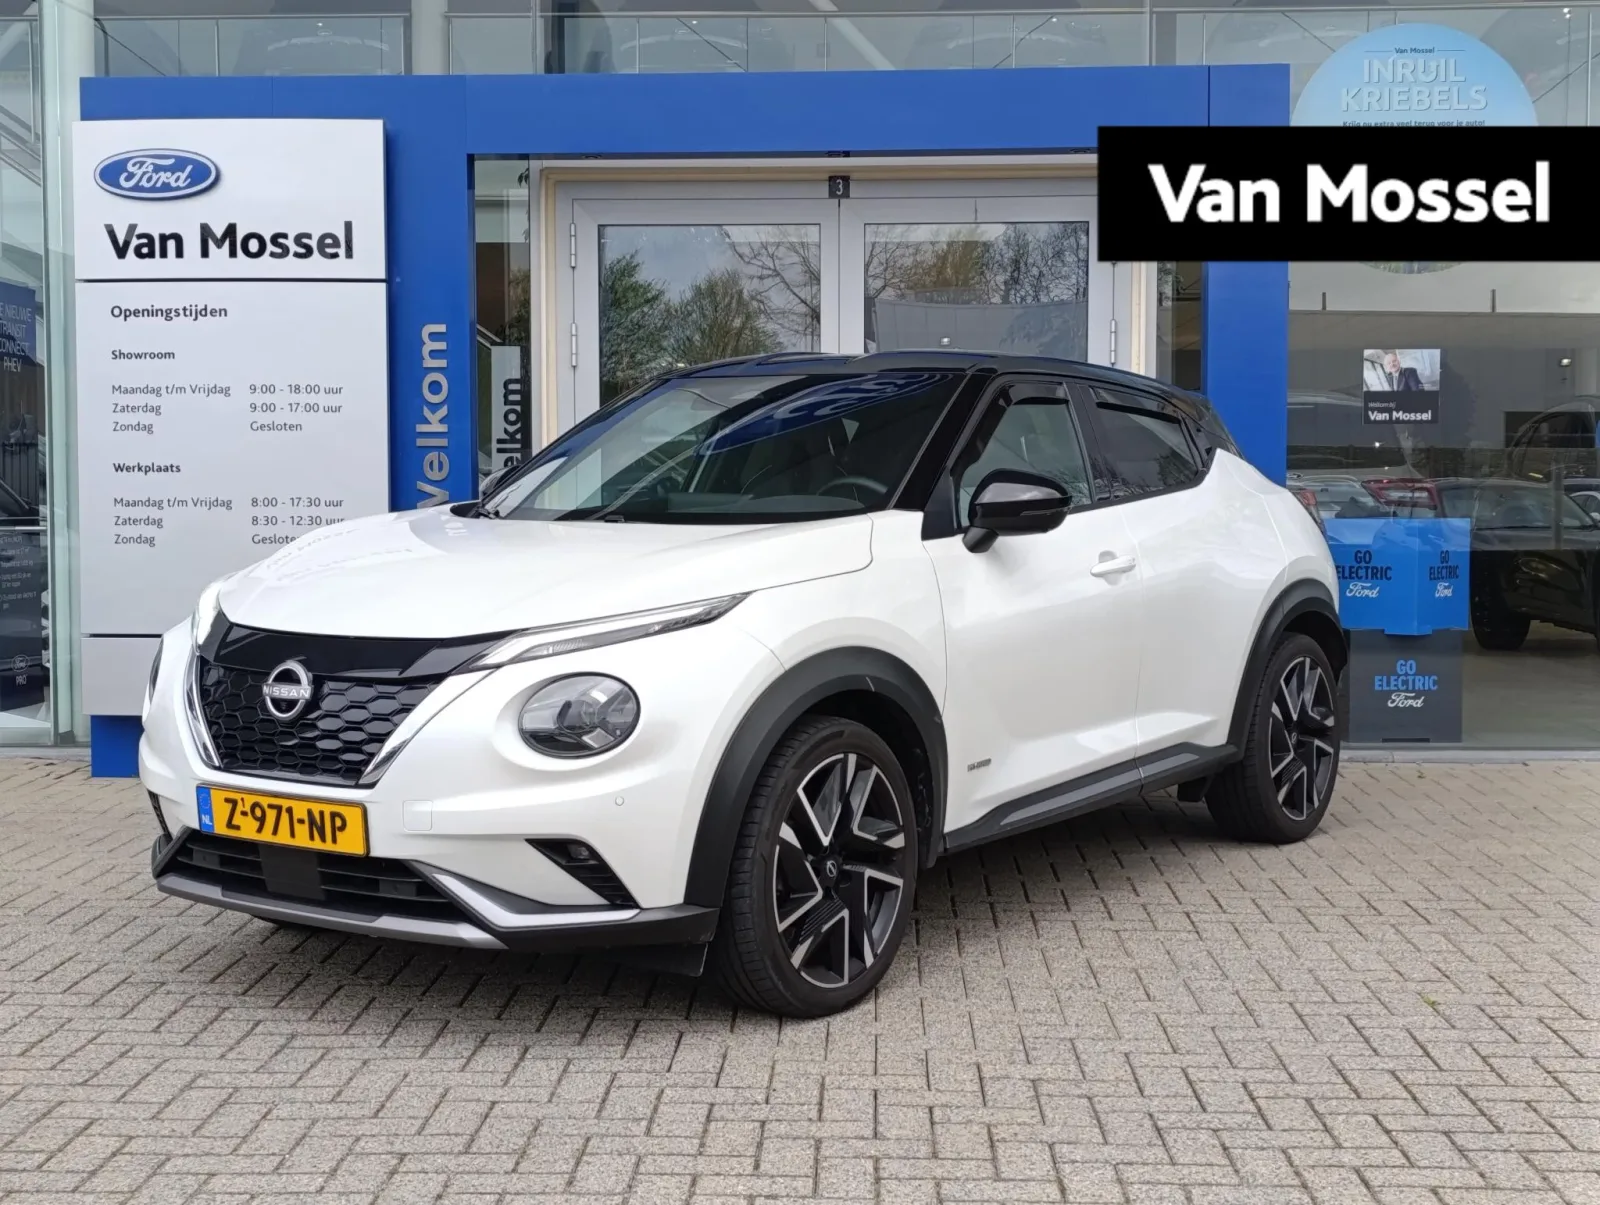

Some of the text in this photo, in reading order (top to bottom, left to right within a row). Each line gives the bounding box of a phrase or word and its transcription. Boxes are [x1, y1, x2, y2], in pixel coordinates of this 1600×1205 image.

[1410, 46, 1435, 54] Mossel
[1363, 58, 1467, 84] INRUIL
[1340, 86, 1488, 112] KRIEBELS
[118, 156, 194, 188] Ford
[836, 179, 843, 195] 3
[103, 220, 354, 260] Van Mossel
[5, 304, 32, 322] NIEUWE
[110, 303, 228, 322] Openingstijden
[0, 320, 26, 338] TRANSIT
[111, 348, 176, 361] Showroom
[3, 356, 22, 372] PHEV
[111, 383, 162, 398] Maandag
[165, 383, 187, 395] t/m
[189, 383, 232, 398] Vrijdag
[249, 383, 276, 395] 9:00
[287, 383, 321, 395] 18:00
[324, 386, 344, 395] uur
[112, 402, 162, 416] Zaterdag
[249, 402, 277, 413] 9:00
[287, 402, 320, 413] 17:00
[322, 405, 343, 413] uur
[1367, 409, 1432, 421] Van Mossel
[112, 420, 303, 435] Zondag Gesloten
[496, 377, 522, 468] elkom
[112, 461, 182, 476] Werkplaats
[113, 496, 164, 511] Maandag
[167, 496, 189, 508] t/m
[191, 496, 233, 511] Vrijdag
[250, 496, 279, 508] 8:00
[289, 496, 322, 508] 17:30
[324, 499, 345, 508] uur
[113, 515, 164, 530] Zaterdag
[251, 515, 279, 527] 8:30
[289, 515, 323, 527] 12:30
[114, 532, 300, 548] Zondag Geslote
[1354, 550, 1373, 564] GO
[1440, 550, 1449, 564] GO
[1336, 565, 1393, 581] ELECTRIC
[1429, 565, 1460, 581] ELECTRIC
[1345, 581, 1380, 598] Ford
[1434, 582, 1453, 598] Ford
[1396, 659, 1417, 675] GO
[1374, 675, 1439, 691] ELECTRIC
[263, 684, 311, 699] NISSAN
[1387, 691, 1425, 708] Ford
[202, 797, 347, 845] NL Z-971-NP
